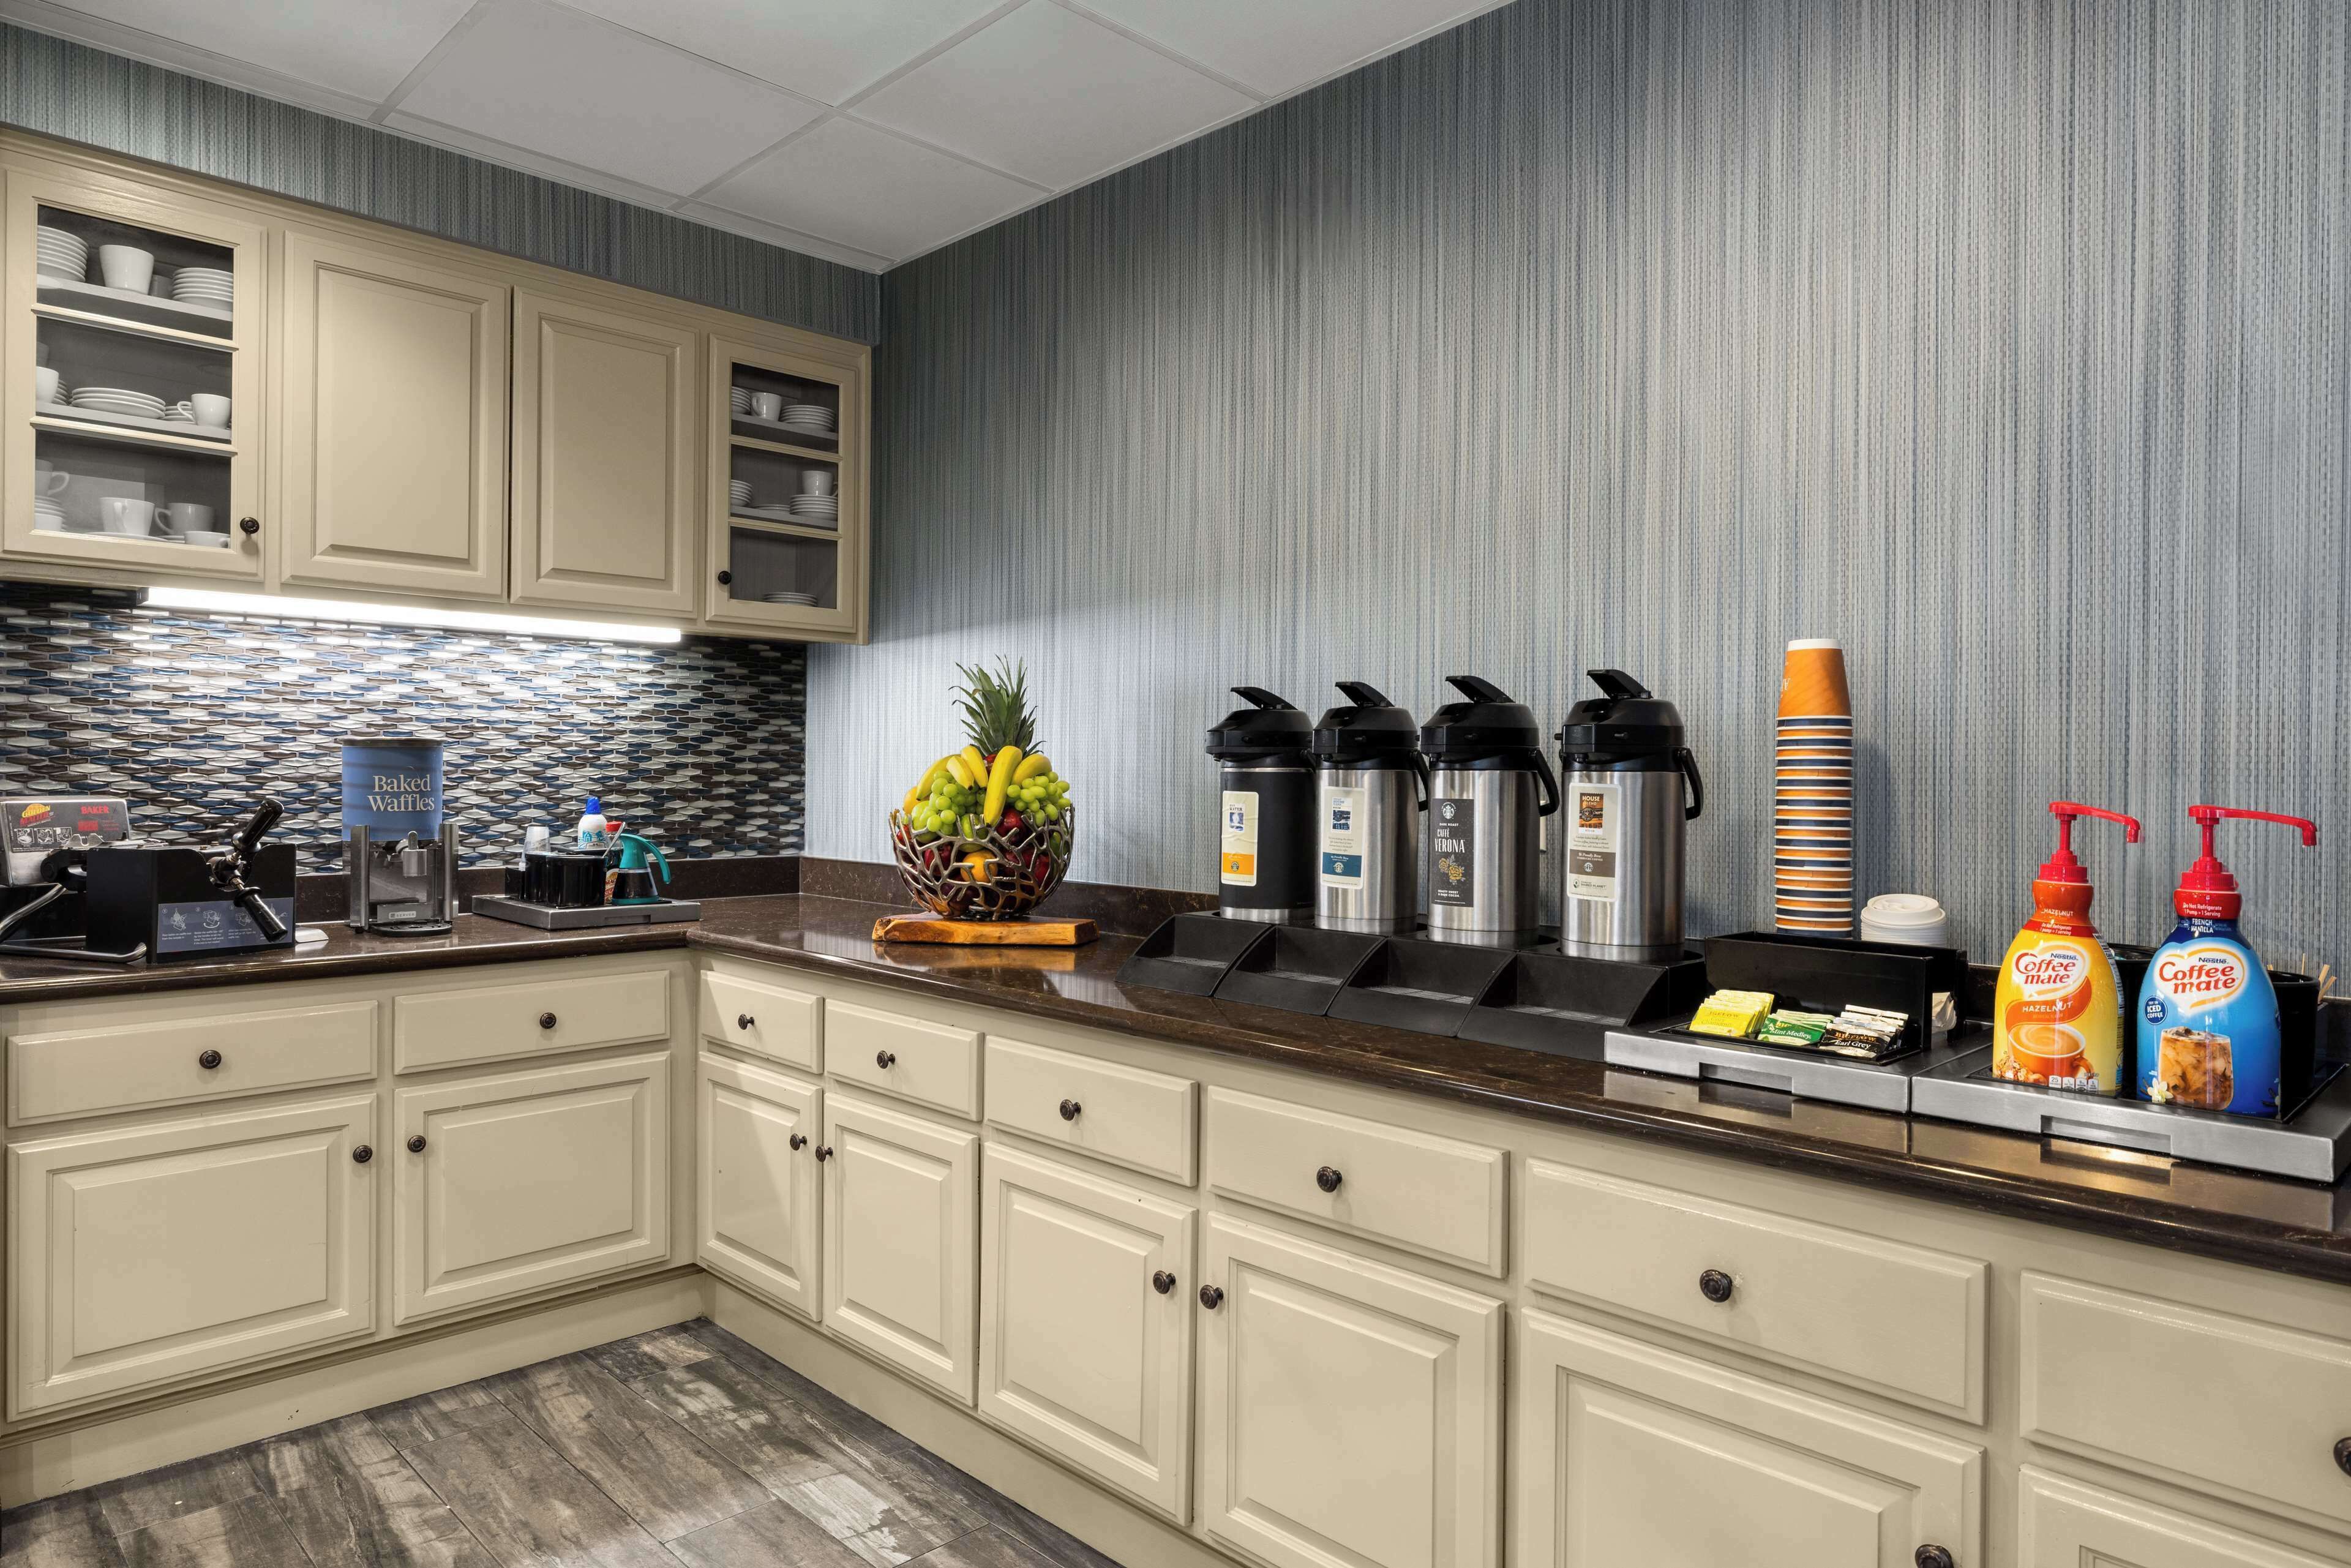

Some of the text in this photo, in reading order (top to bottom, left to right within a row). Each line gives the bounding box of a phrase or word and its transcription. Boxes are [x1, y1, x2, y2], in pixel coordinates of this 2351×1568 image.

[373, 775, 431, 792] Baked
[81, 805, 110, 814] BAKER
[367, 793, 434, 812] Waffles
[1434, 838, 1465, 853] VERONA
[2015, 953, 2076, 974] Coffee
[2024, 973, 2071, 985] mate
[2159, 961, 2235, 982] Coffee
[2173, 977, 2236, 994] mate
[2022, 1000, 2073, 1013] HAZELNUT
[1834, 1032, 1876, 1042] BIGELOW
[1851, 1041, 1871, 1050] Grey
